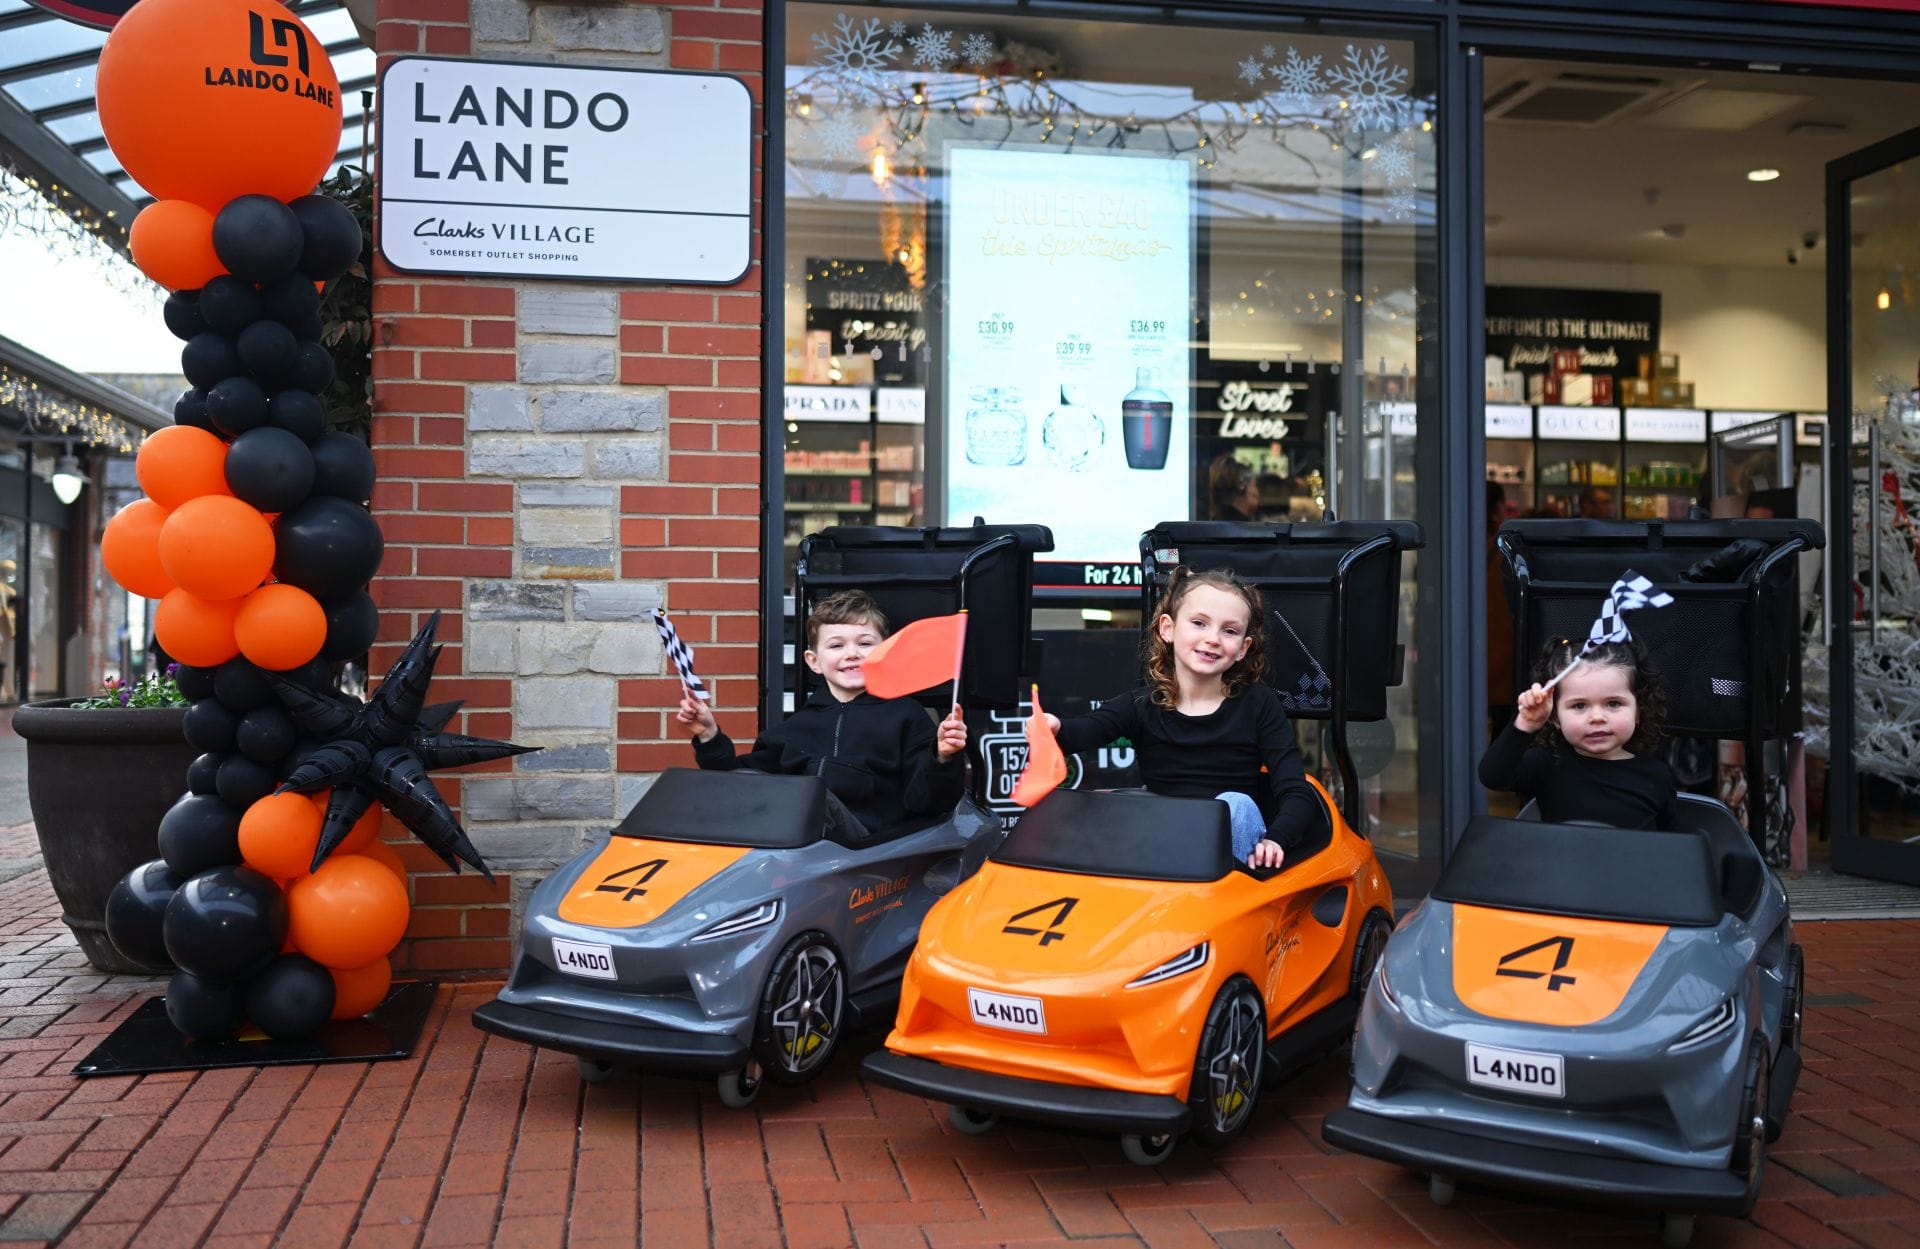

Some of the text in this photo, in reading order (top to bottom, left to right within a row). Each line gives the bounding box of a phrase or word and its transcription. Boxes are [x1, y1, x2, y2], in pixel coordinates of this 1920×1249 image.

[205, 66, 334, 110] LANDO LANE
[415, 82, 629, 132] LANDO
[414, 138, 569, 185] LANE
[413, 217, 595, 244] Clarks VILLAGE
[430, 249, 579, 262] SOMERSET OUTLET SHOPPING
[828, 291, 880, 309] SPRITZ
[978, 321, 1015, 334] £30.99
[1130, 320, 1166, 333] £36.99
[1546, 319, 1560, 338] IS
[1562, 320, 1587, 339] THE
[1589, 320, 1651, 341] ULTIMATE
[1056, 342, 1092, 355] £39.99
[1218, 380, 1294, 413] Street
[1219, 412, 1289, 439] Loves
[1545, 414, 1615, 431] GUCCI
[1085, 565, 1109, 585] For
[1112, 565, 1131, 585] 24
[1000, 746, 1030, 771] 15%
[596, 858, 670, 902] 4
[1002, 896, 1079, 947] 4
[557, 948, 609, 971] L4NDO
[1495, 935, 1576, 991] 4
[974, 998, 1039, 1026] L4NDO
[1473, 1055, 1556, 1086] L4NDO
